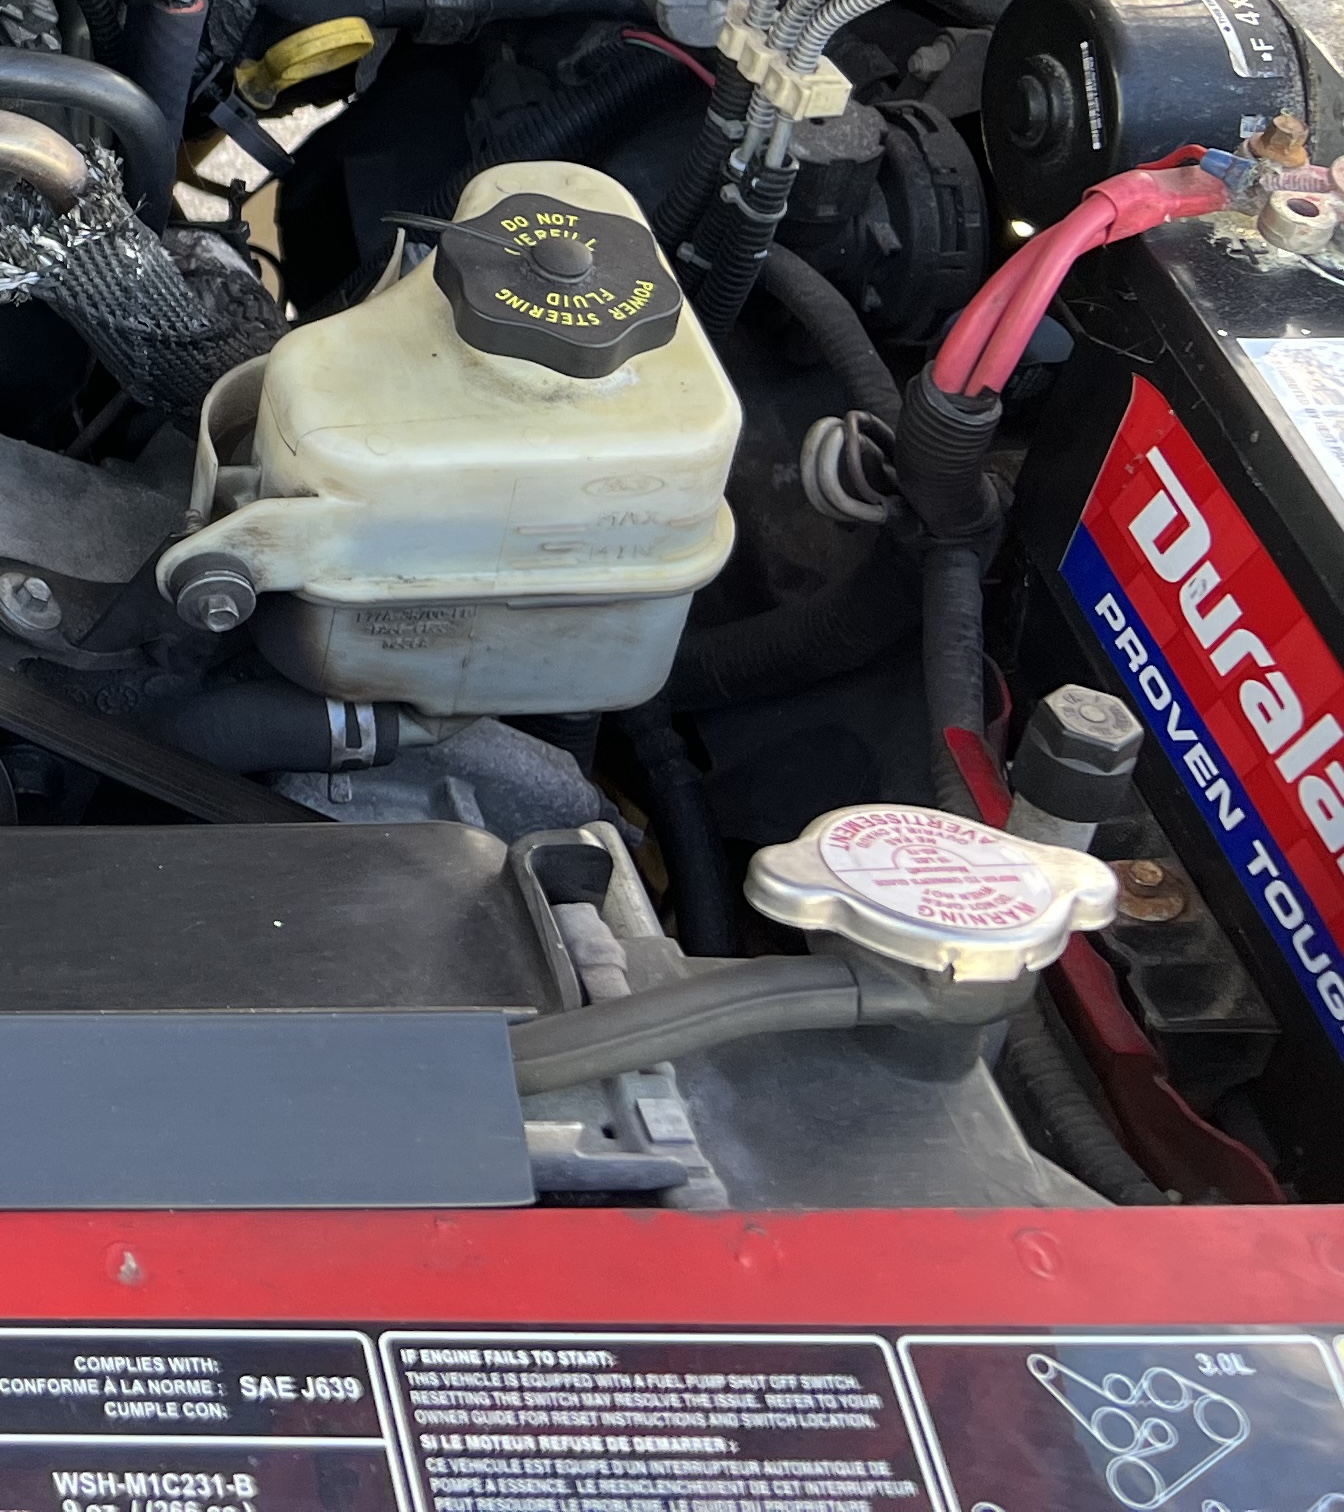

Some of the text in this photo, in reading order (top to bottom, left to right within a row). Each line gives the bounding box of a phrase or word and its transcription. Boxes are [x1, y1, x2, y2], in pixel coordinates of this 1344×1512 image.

[500, 213, 579, 231] DO NOT
[494, 279, 655, 326] POWER STEERING
[546, 288, 615, 308] FLUID
[1128, 445, 1344, 878] Durala
[1094, 592, 1245, 831] PROVEN
[1247, 839, 1344, 1035] TOUG
[827, 813, 998, 851] AVERTISSEMENT
[918, 900, 1037, 925] WARNING
[74, 1356, 222, 1374] COMPLIES WITH:
[400, 1349, 419, 1365] IF
[420, 1349, 482, 1365] ENGINE
[483, 1349, 530, 1366] FAILS
[531, 1350, 555, 1366] TO
[1194, 1352, 1256, 1377] 3.0L
[104, 1375, 117, 1396] À
[120, 1379, 144, 1396] LA
[148, 1379, 213, 1397] NORME
[239, 1375, 363, 1402] SAE J639
[104, 1401, 231, 1420] CUMPLE CON:
[52, 1471, 259, 1499] WSH-M1C231-B
